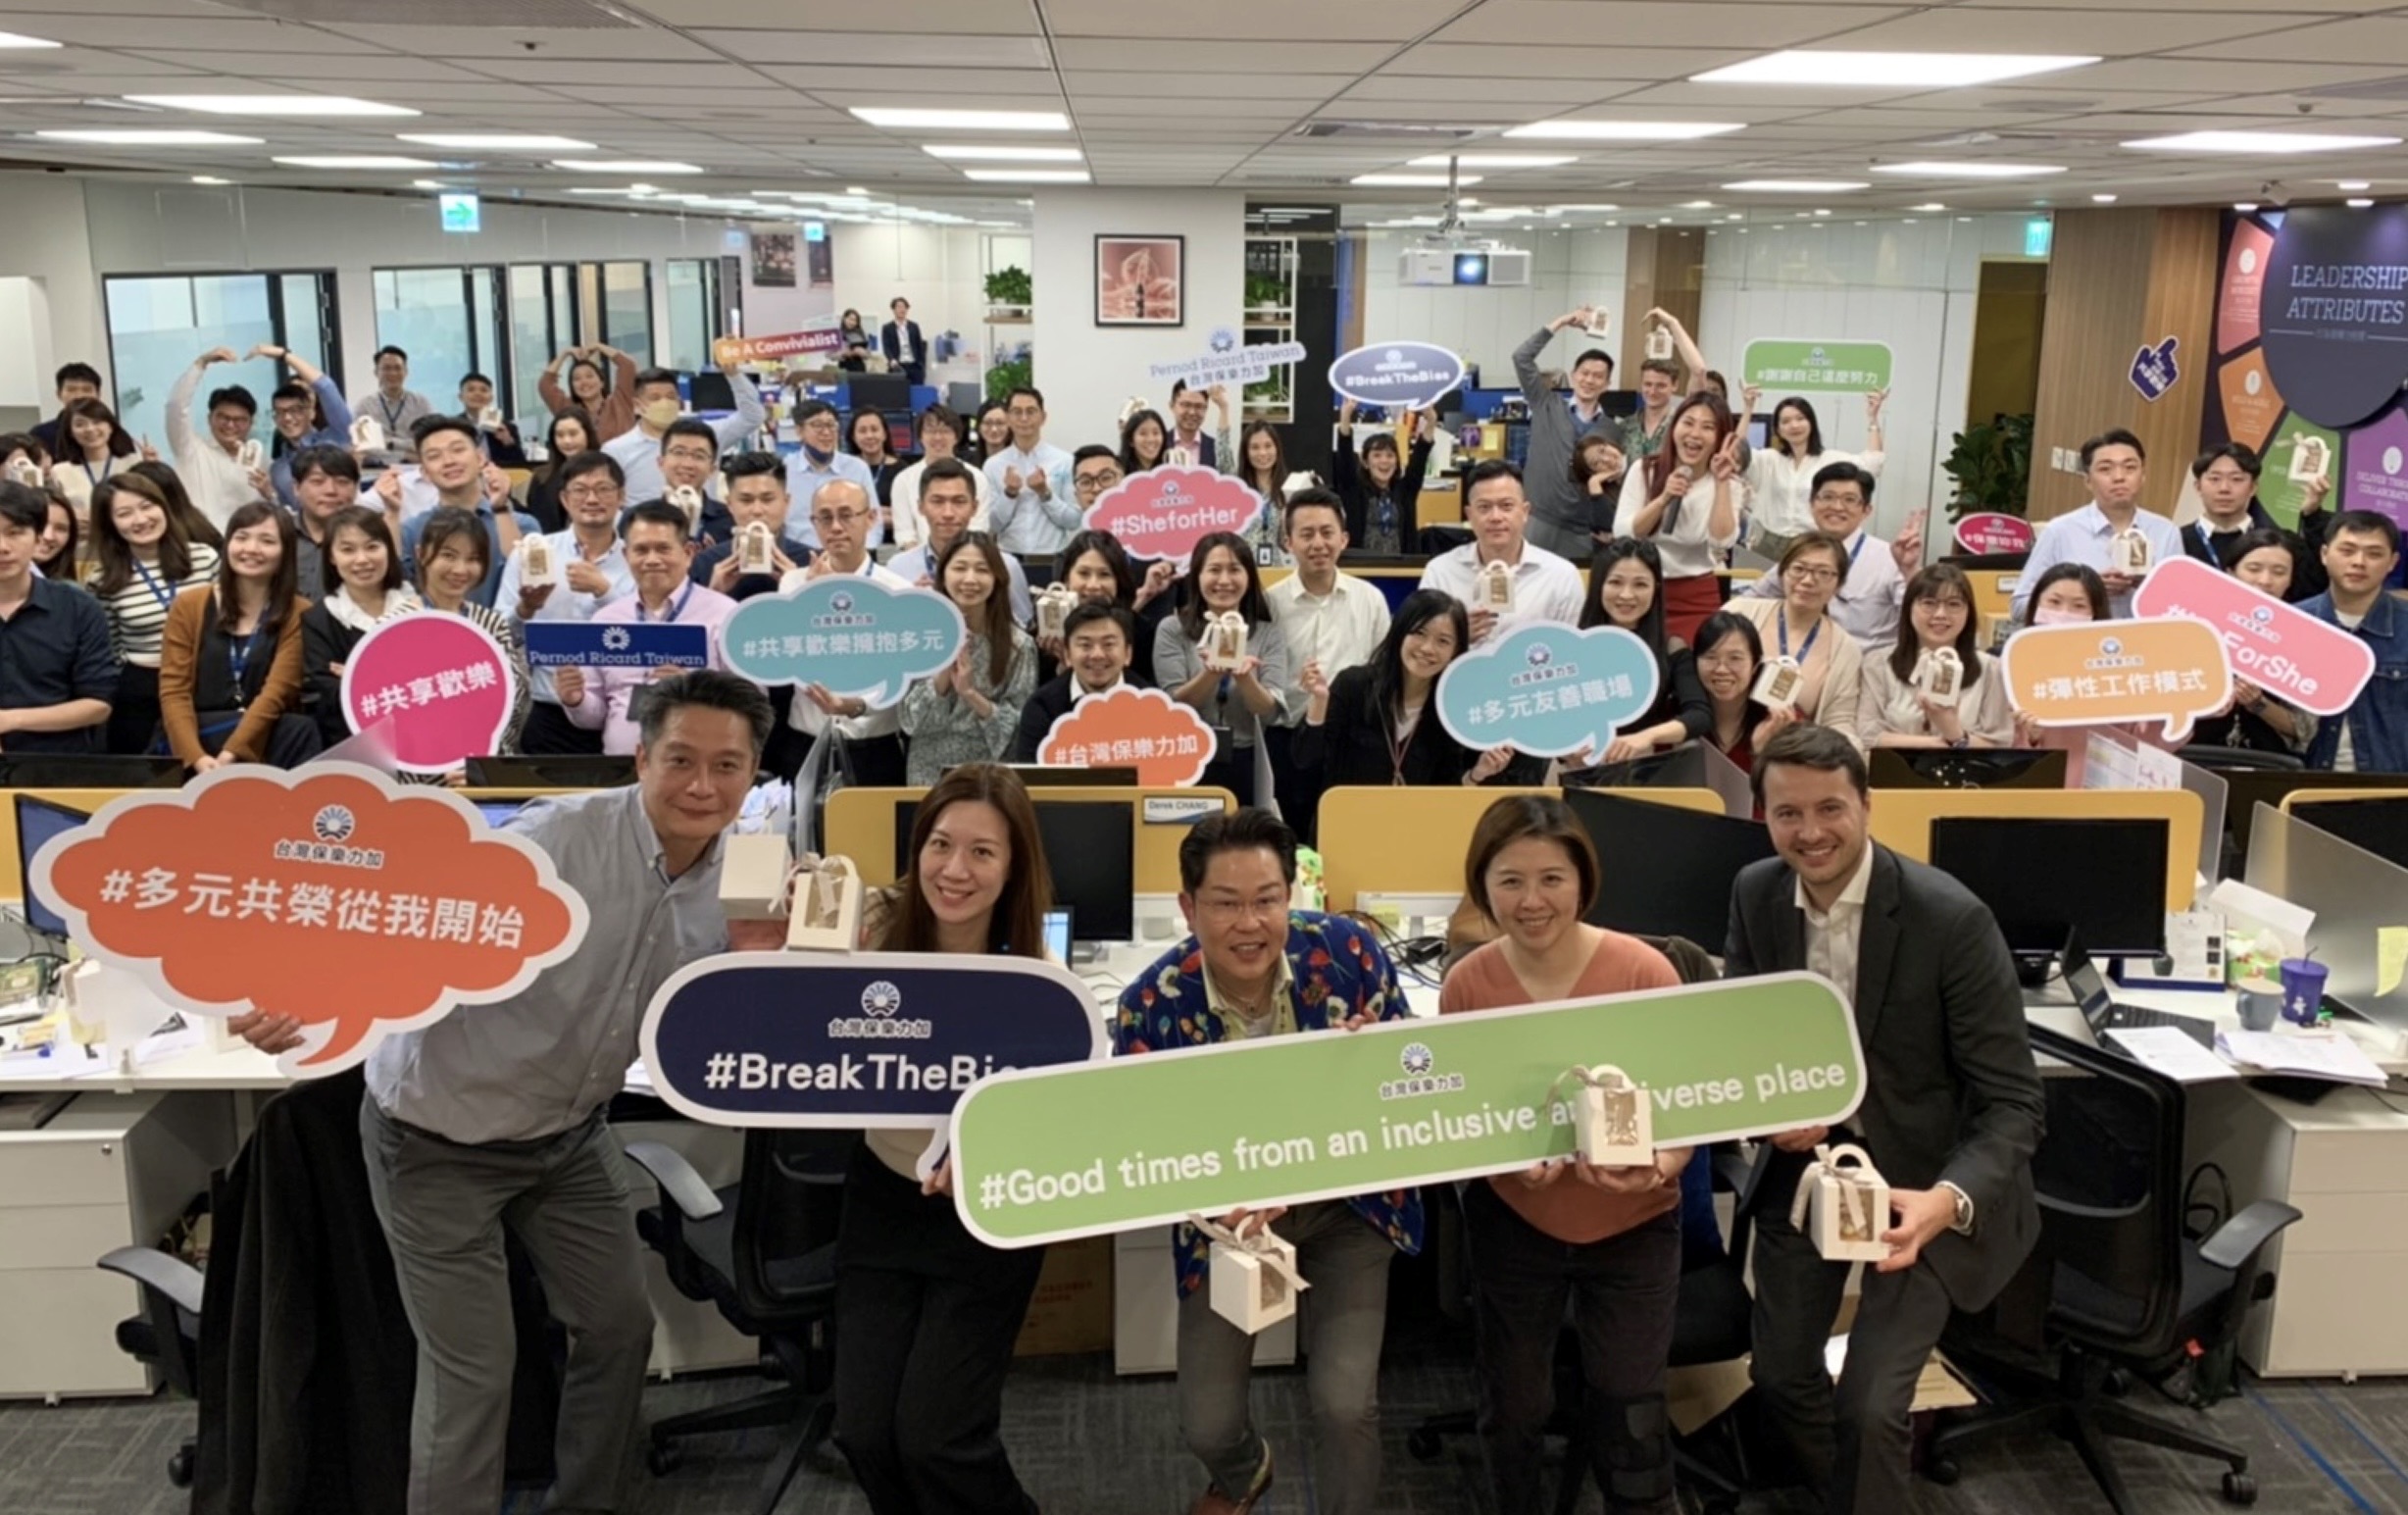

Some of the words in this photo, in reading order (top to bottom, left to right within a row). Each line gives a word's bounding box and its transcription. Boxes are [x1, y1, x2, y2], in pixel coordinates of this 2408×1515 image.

[2290, 265, 2408, 290] LEADERSHIP
[2285, 296, 2404, 324] ATTRIBUTES
[722, 346, 740, 357] Be
[743, 343, 754, 355] A
[756, 333, 839, 353] Convivialist
[1150, 360, 1197, 377] Pernod
[1200, 352, 1246, 369] Ricard
[1247, 346, 1301, 363] Taiwan
[1345, 370, 1450, 386] #BreakTheBias
[1111, 506, 1238, 535] #SheforHer
[529, 651, 585, 665] Pernod
[589, 651, 642, 665] Ricard
[644, 652, 704, 666] Taiwan
[742, 629, 945, 658] #共享歡樂擁抱多元
[360, 660, 498, 718] #共享歡樂
[1468, 674, 1633, 725] #多元友善職場
[2032, 668, 2208, 700] #彈性工作模式
[1055, 733, 1198, 766] #台灣保樂力加
[100, 866, 525, 949] #多元共榮從我開始
[704, 1052, 1037, 1091] #BreakTheBi
[979, 1158, 1105, 1210] #Good
[1118, 1151, 1222, 1187] times
[1233, 1136, 1316, 1172] from
[1328, 1129, 1368, 1158] an
[1380, 1103, 1536, 1151] inclusive
[1755, 1063, 1846, 1103] place
